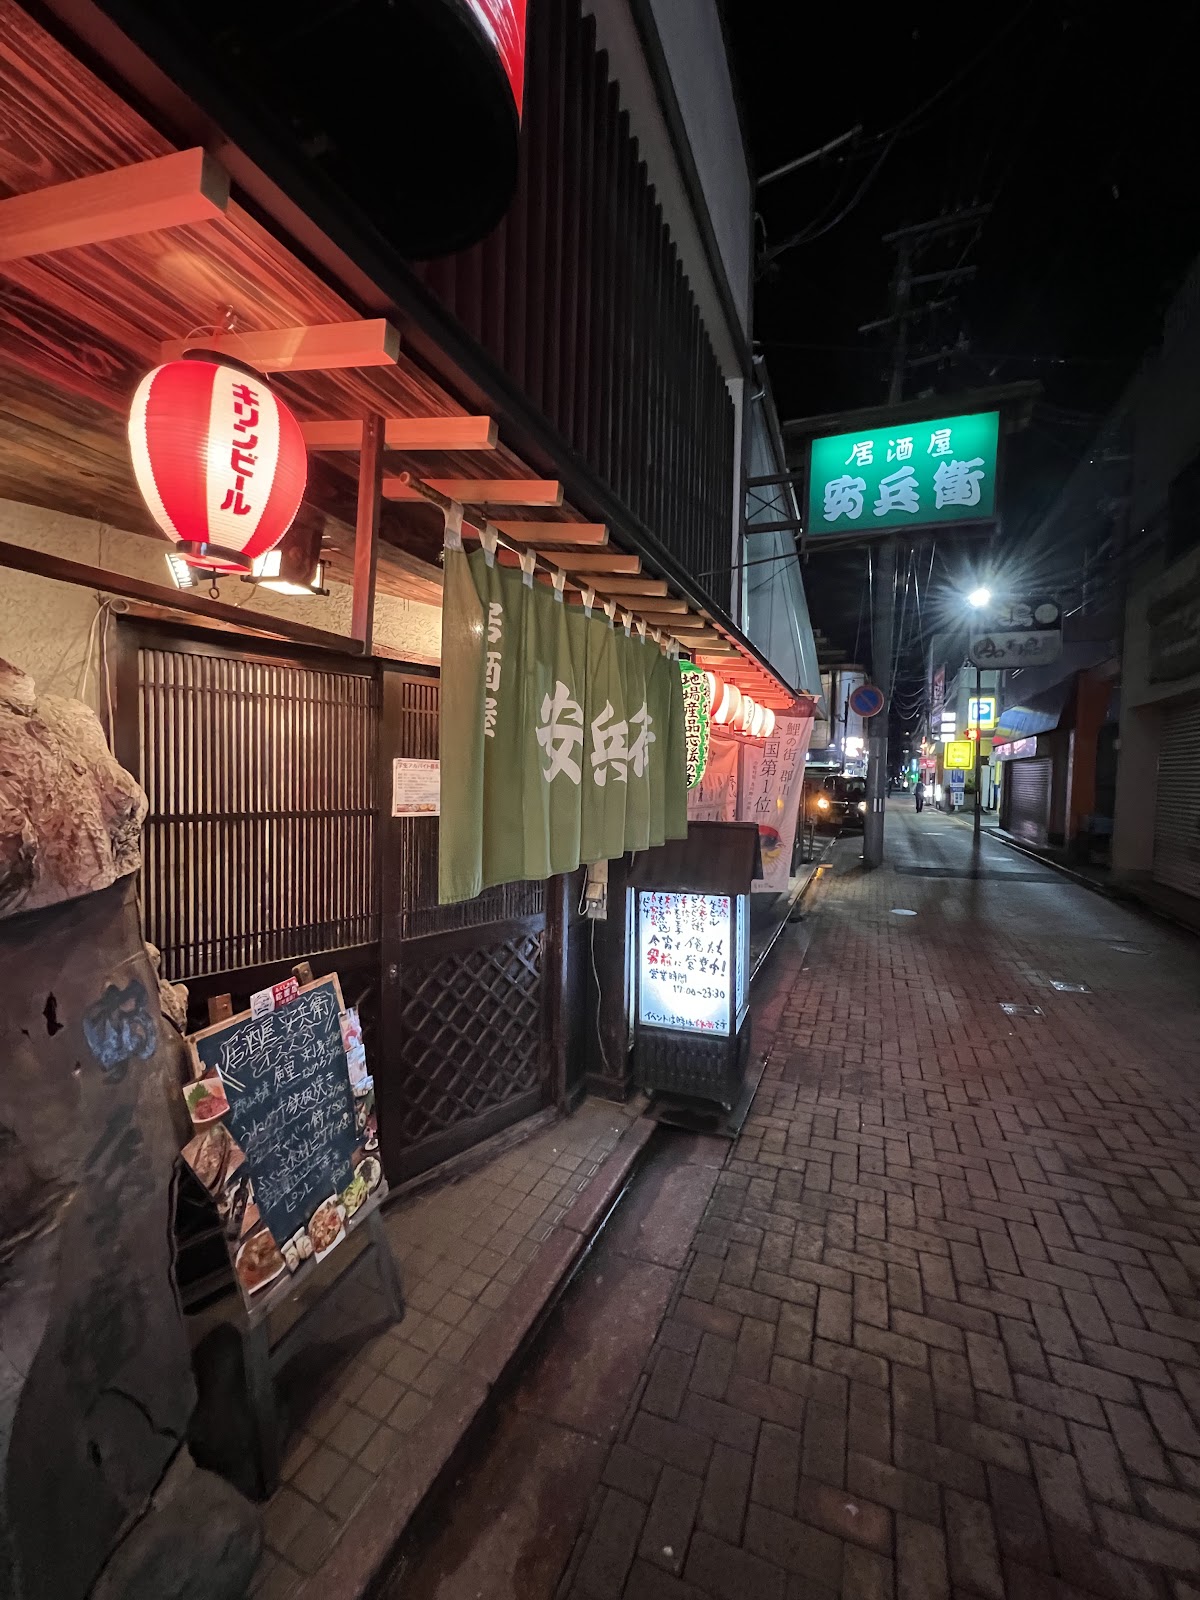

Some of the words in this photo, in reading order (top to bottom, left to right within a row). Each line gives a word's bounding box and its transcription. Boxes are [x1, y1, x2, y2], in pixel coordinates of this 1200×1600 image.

[220, 382, 260, 516] キリンビール
[844, 428, 954, 467] 居酒屋
[823, 457, 985, 522] 安兵衛
[972, 703, 990, 719] P
[649, 968, 687, 984] 営業時間
[224, 1015, 277, 1073] 居酒屋
[279, 995, 330, 1033] 安兵衛
[256, 1032, 311, 1074] オススメ
[301, 1040, 325, 1062] 刺身
[274, 1055, 301, 1093] 鯉
